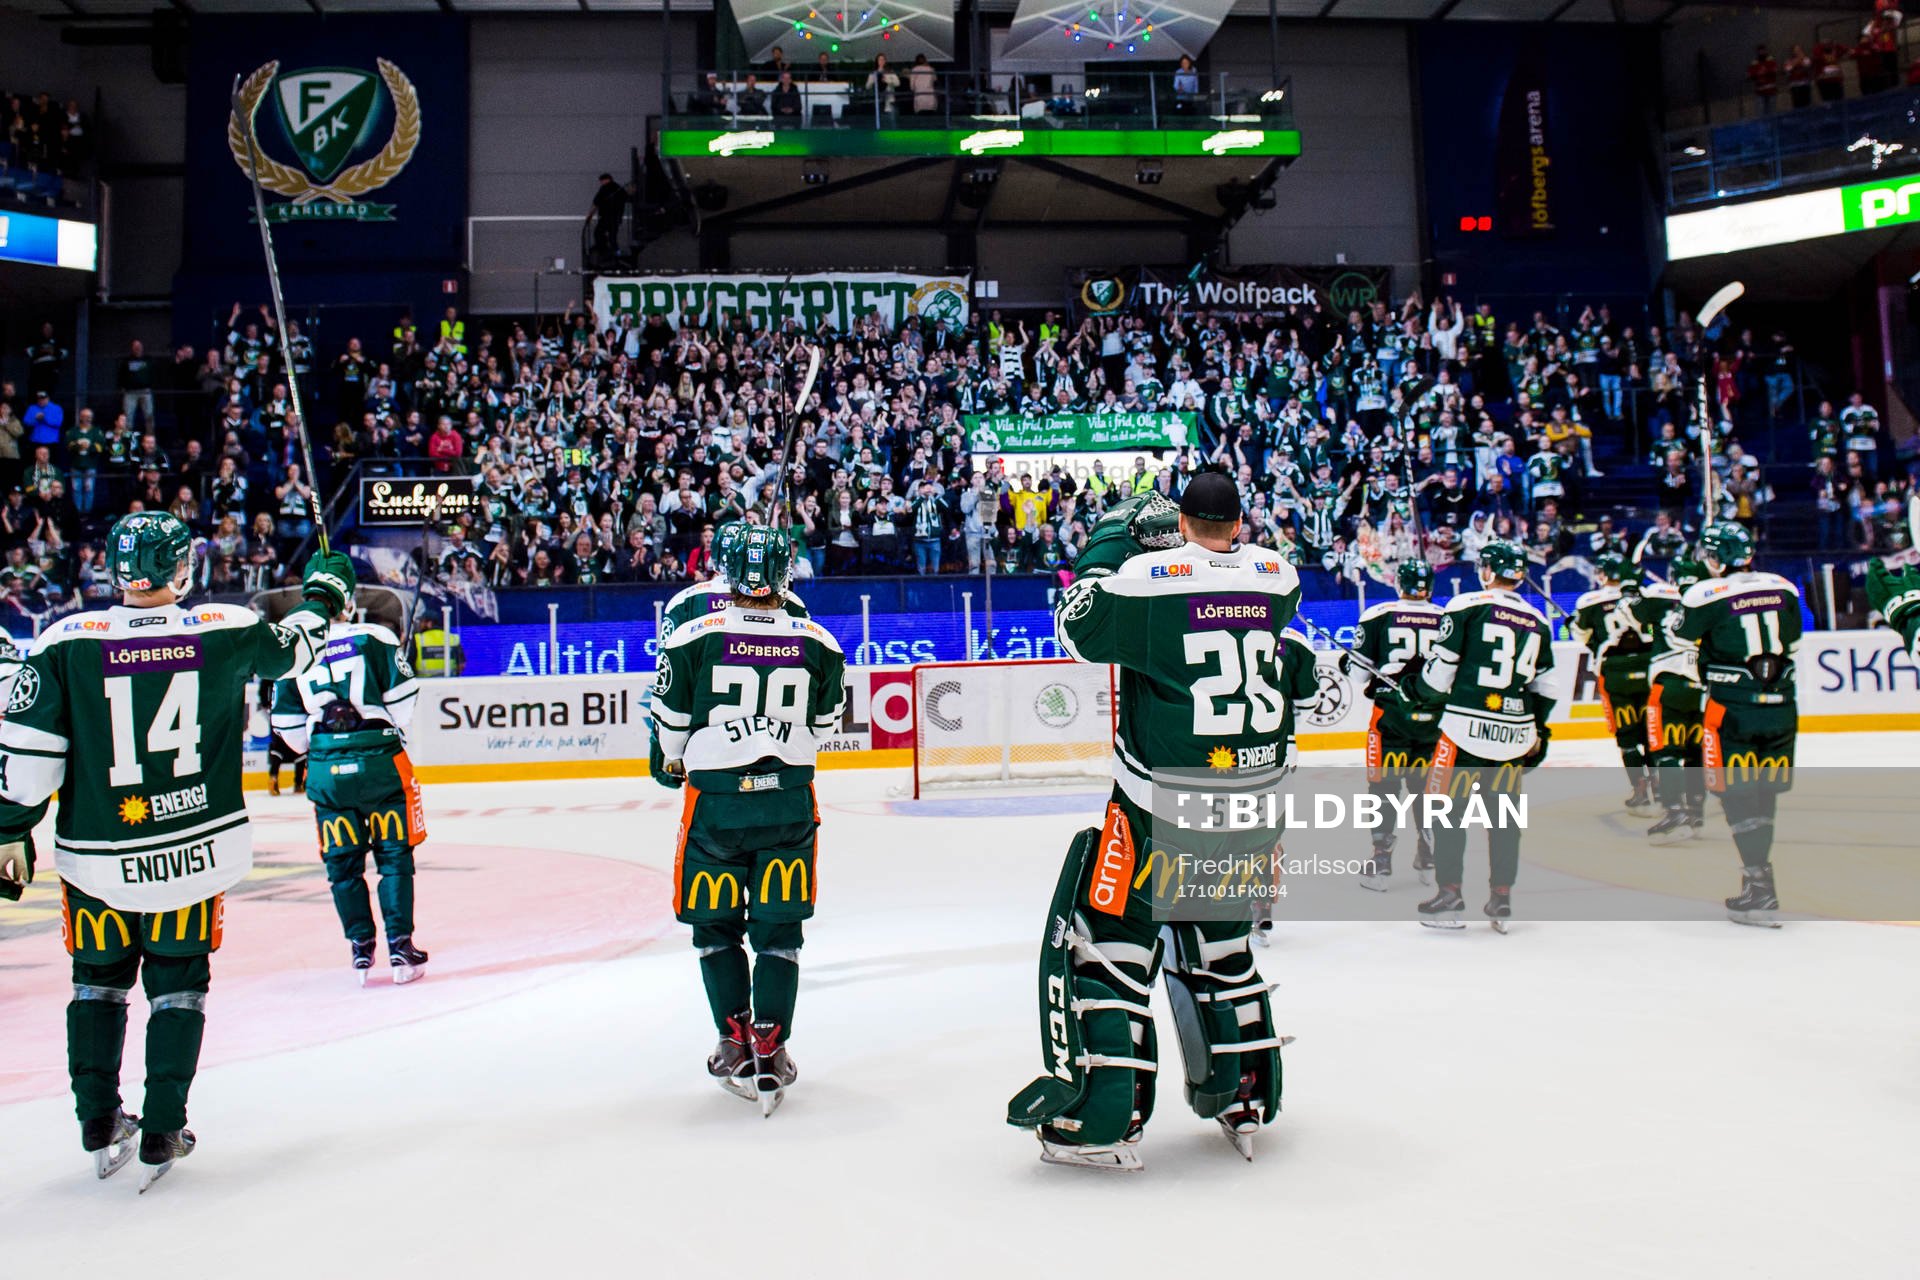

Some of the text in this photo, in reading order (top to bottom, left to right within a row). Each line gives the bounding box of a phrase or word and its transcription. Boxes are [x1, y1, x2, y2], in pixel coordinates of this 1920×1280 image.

[300, 81, 331, 126] F
[313, 107, 349, 153] BK
[278, 204, 368, 217] KARLSTAD
[1139, 281, 1317, 308] The Wolfpack
[996, 419, 1014, 432] Vila
[1087, 416, 1107, 430] Vila
[1151, 563, 1192, 578] ELON
[1254, 561, 1280, 574] ELON
[128, 616, 166, 627] CCM
[182, 611, 225, 626] ELON
[744, 615, 774, 623] CCM
[1196, 604, 1267, 619] LÖFBERGS
[63, 621, 111, 632] ELON
[1740, 611, 1783, 661] 11
[109, 645, 196, 664] LÖFBERGS
[729, 641, 800, 657] LÖFBERGS
[1477, 622, 1542, 690] 34
[1818, 647, 1920, 692] SKA
[1183, 630, 1284, 735] 26
[440, 690, 628, 730] Svema Bil
[104, 670, 201, 787] 14
[725, 716, 792, 743] STEEN
[121, 839, 216, 884] ENQVIST
[1048, 975, 1073, 1082] CCM
